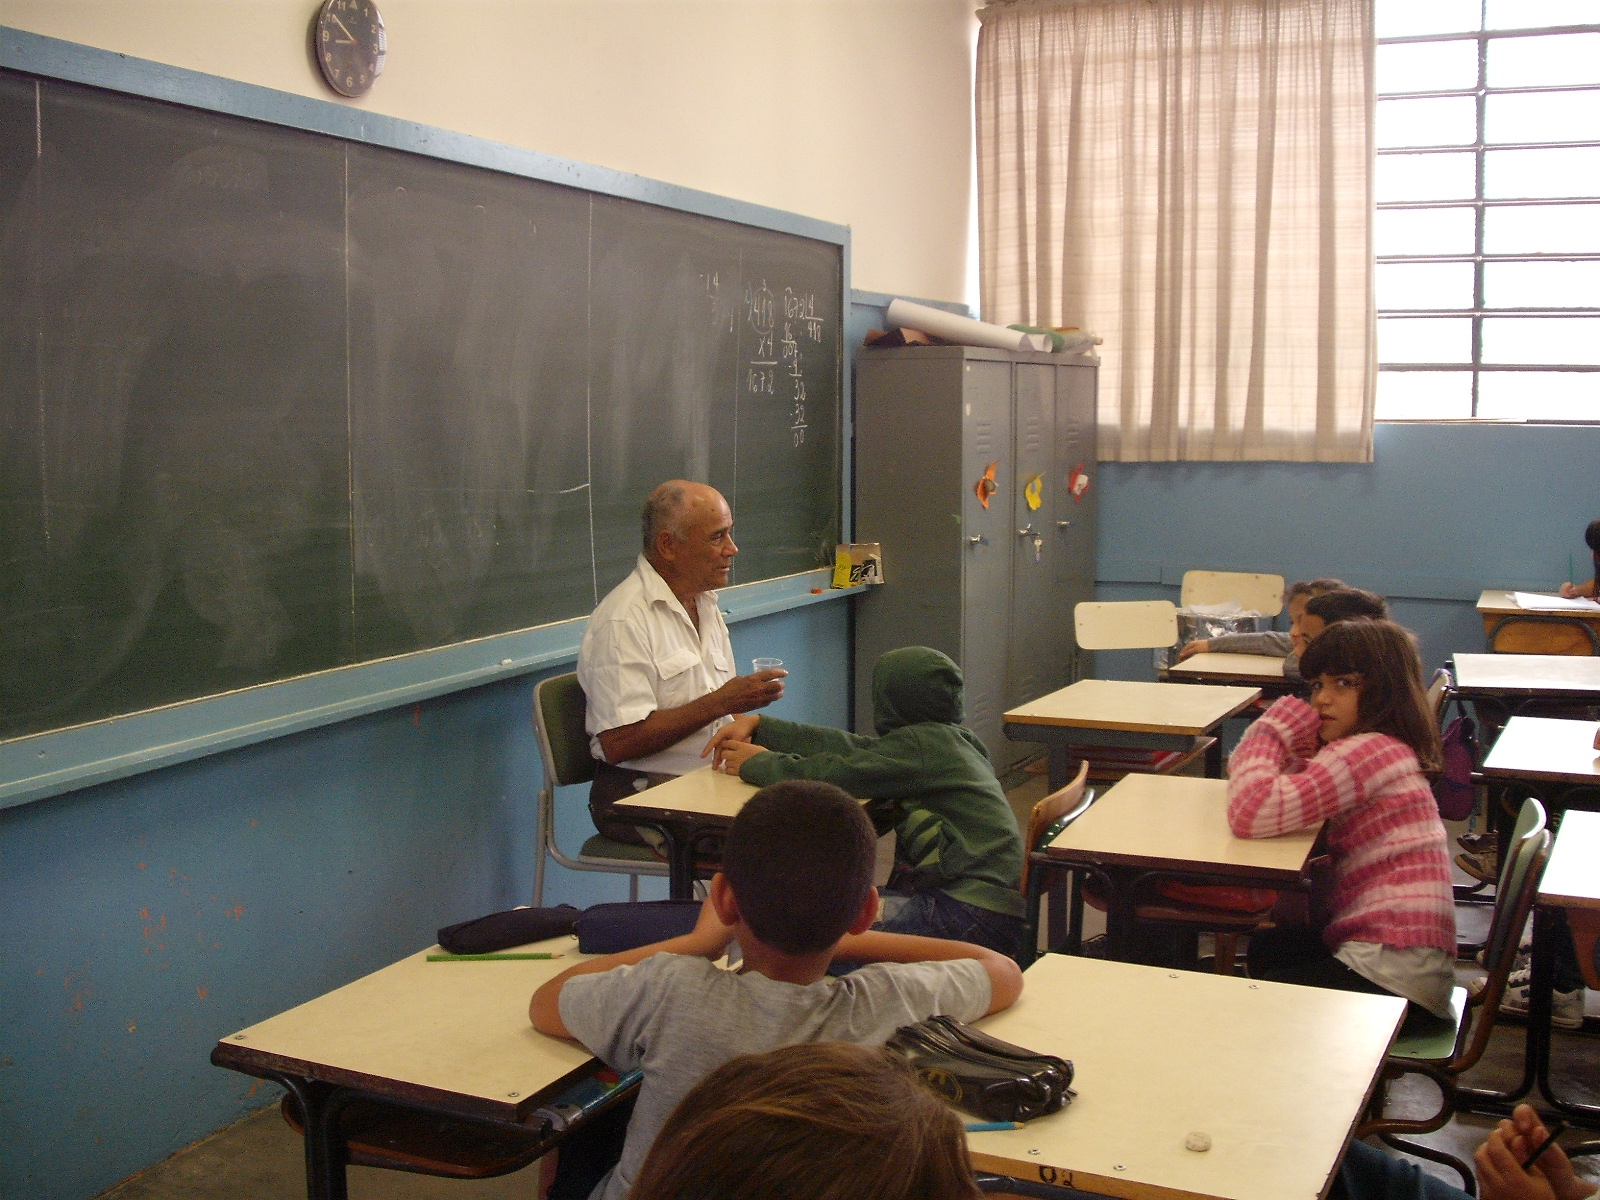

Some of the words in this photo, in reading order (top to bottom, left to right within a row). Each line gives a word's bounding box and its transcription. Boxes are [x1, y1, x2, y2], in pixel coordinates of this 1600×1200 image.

[322, 30, 330, 42] 9
[373, 43, 379, 54] 3
[346, 76, 353, 88] 6
